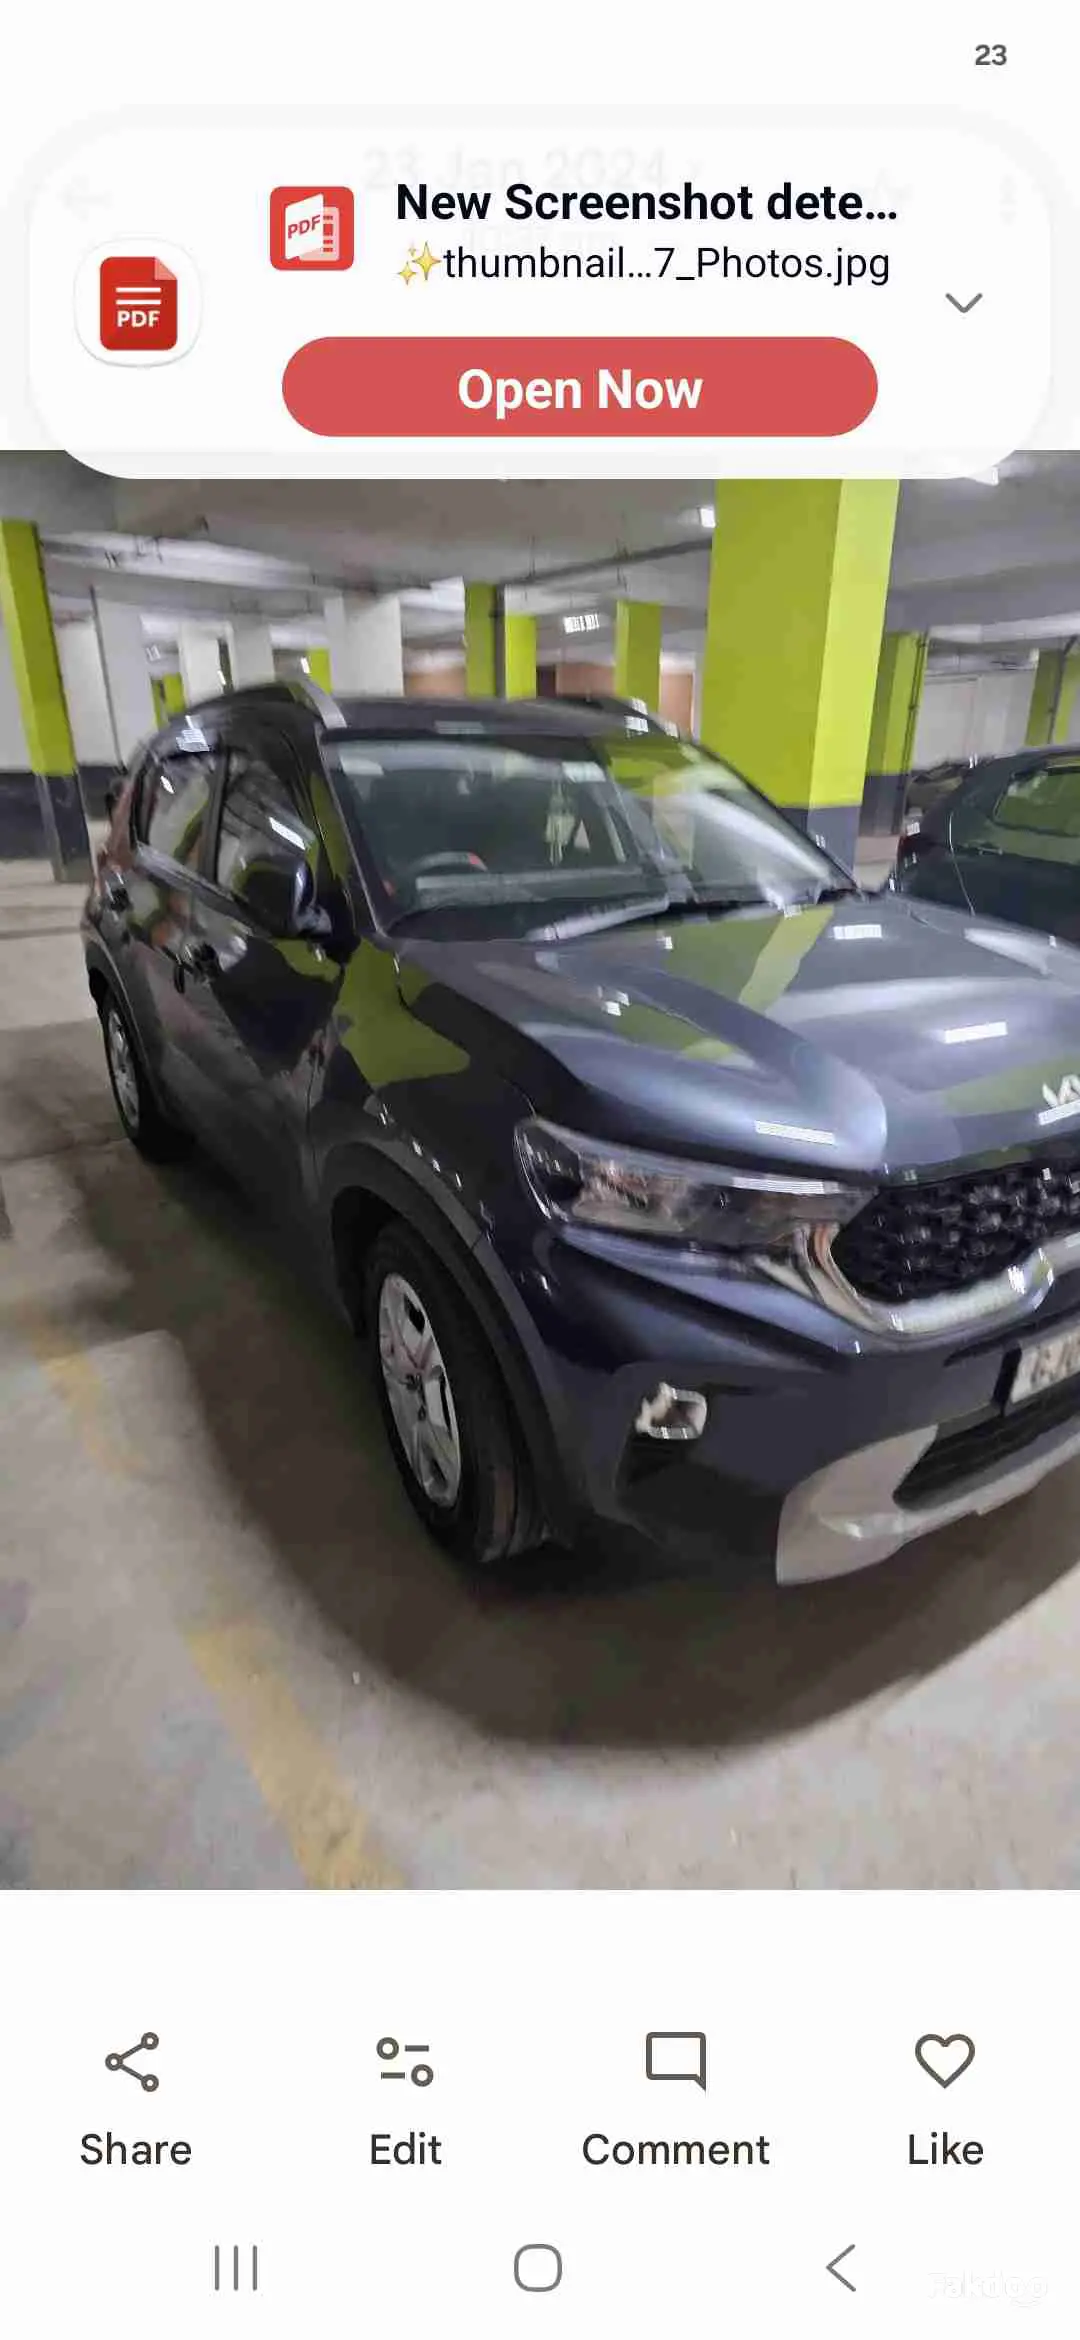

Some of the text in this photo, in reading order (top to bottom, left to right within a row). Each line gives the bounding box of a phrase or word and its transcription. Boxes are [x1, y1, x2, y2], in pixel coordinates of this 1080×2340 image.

[975, 44, 1007, 66] 23
[398, 184, 491, 220] New
[505, 182, 753, 220] Screenshot
[288, 214, 321, 240] PDF
[118, 311, 160, 327] PDF
[459, 369, 703, 419] Open Now
[81, 2132, 191, 2165] Share
[371, 2132, 441, 2165] Edit
[583, 2134, 769, 2165] Comment
[909, 2132, 983, 2165] Like
